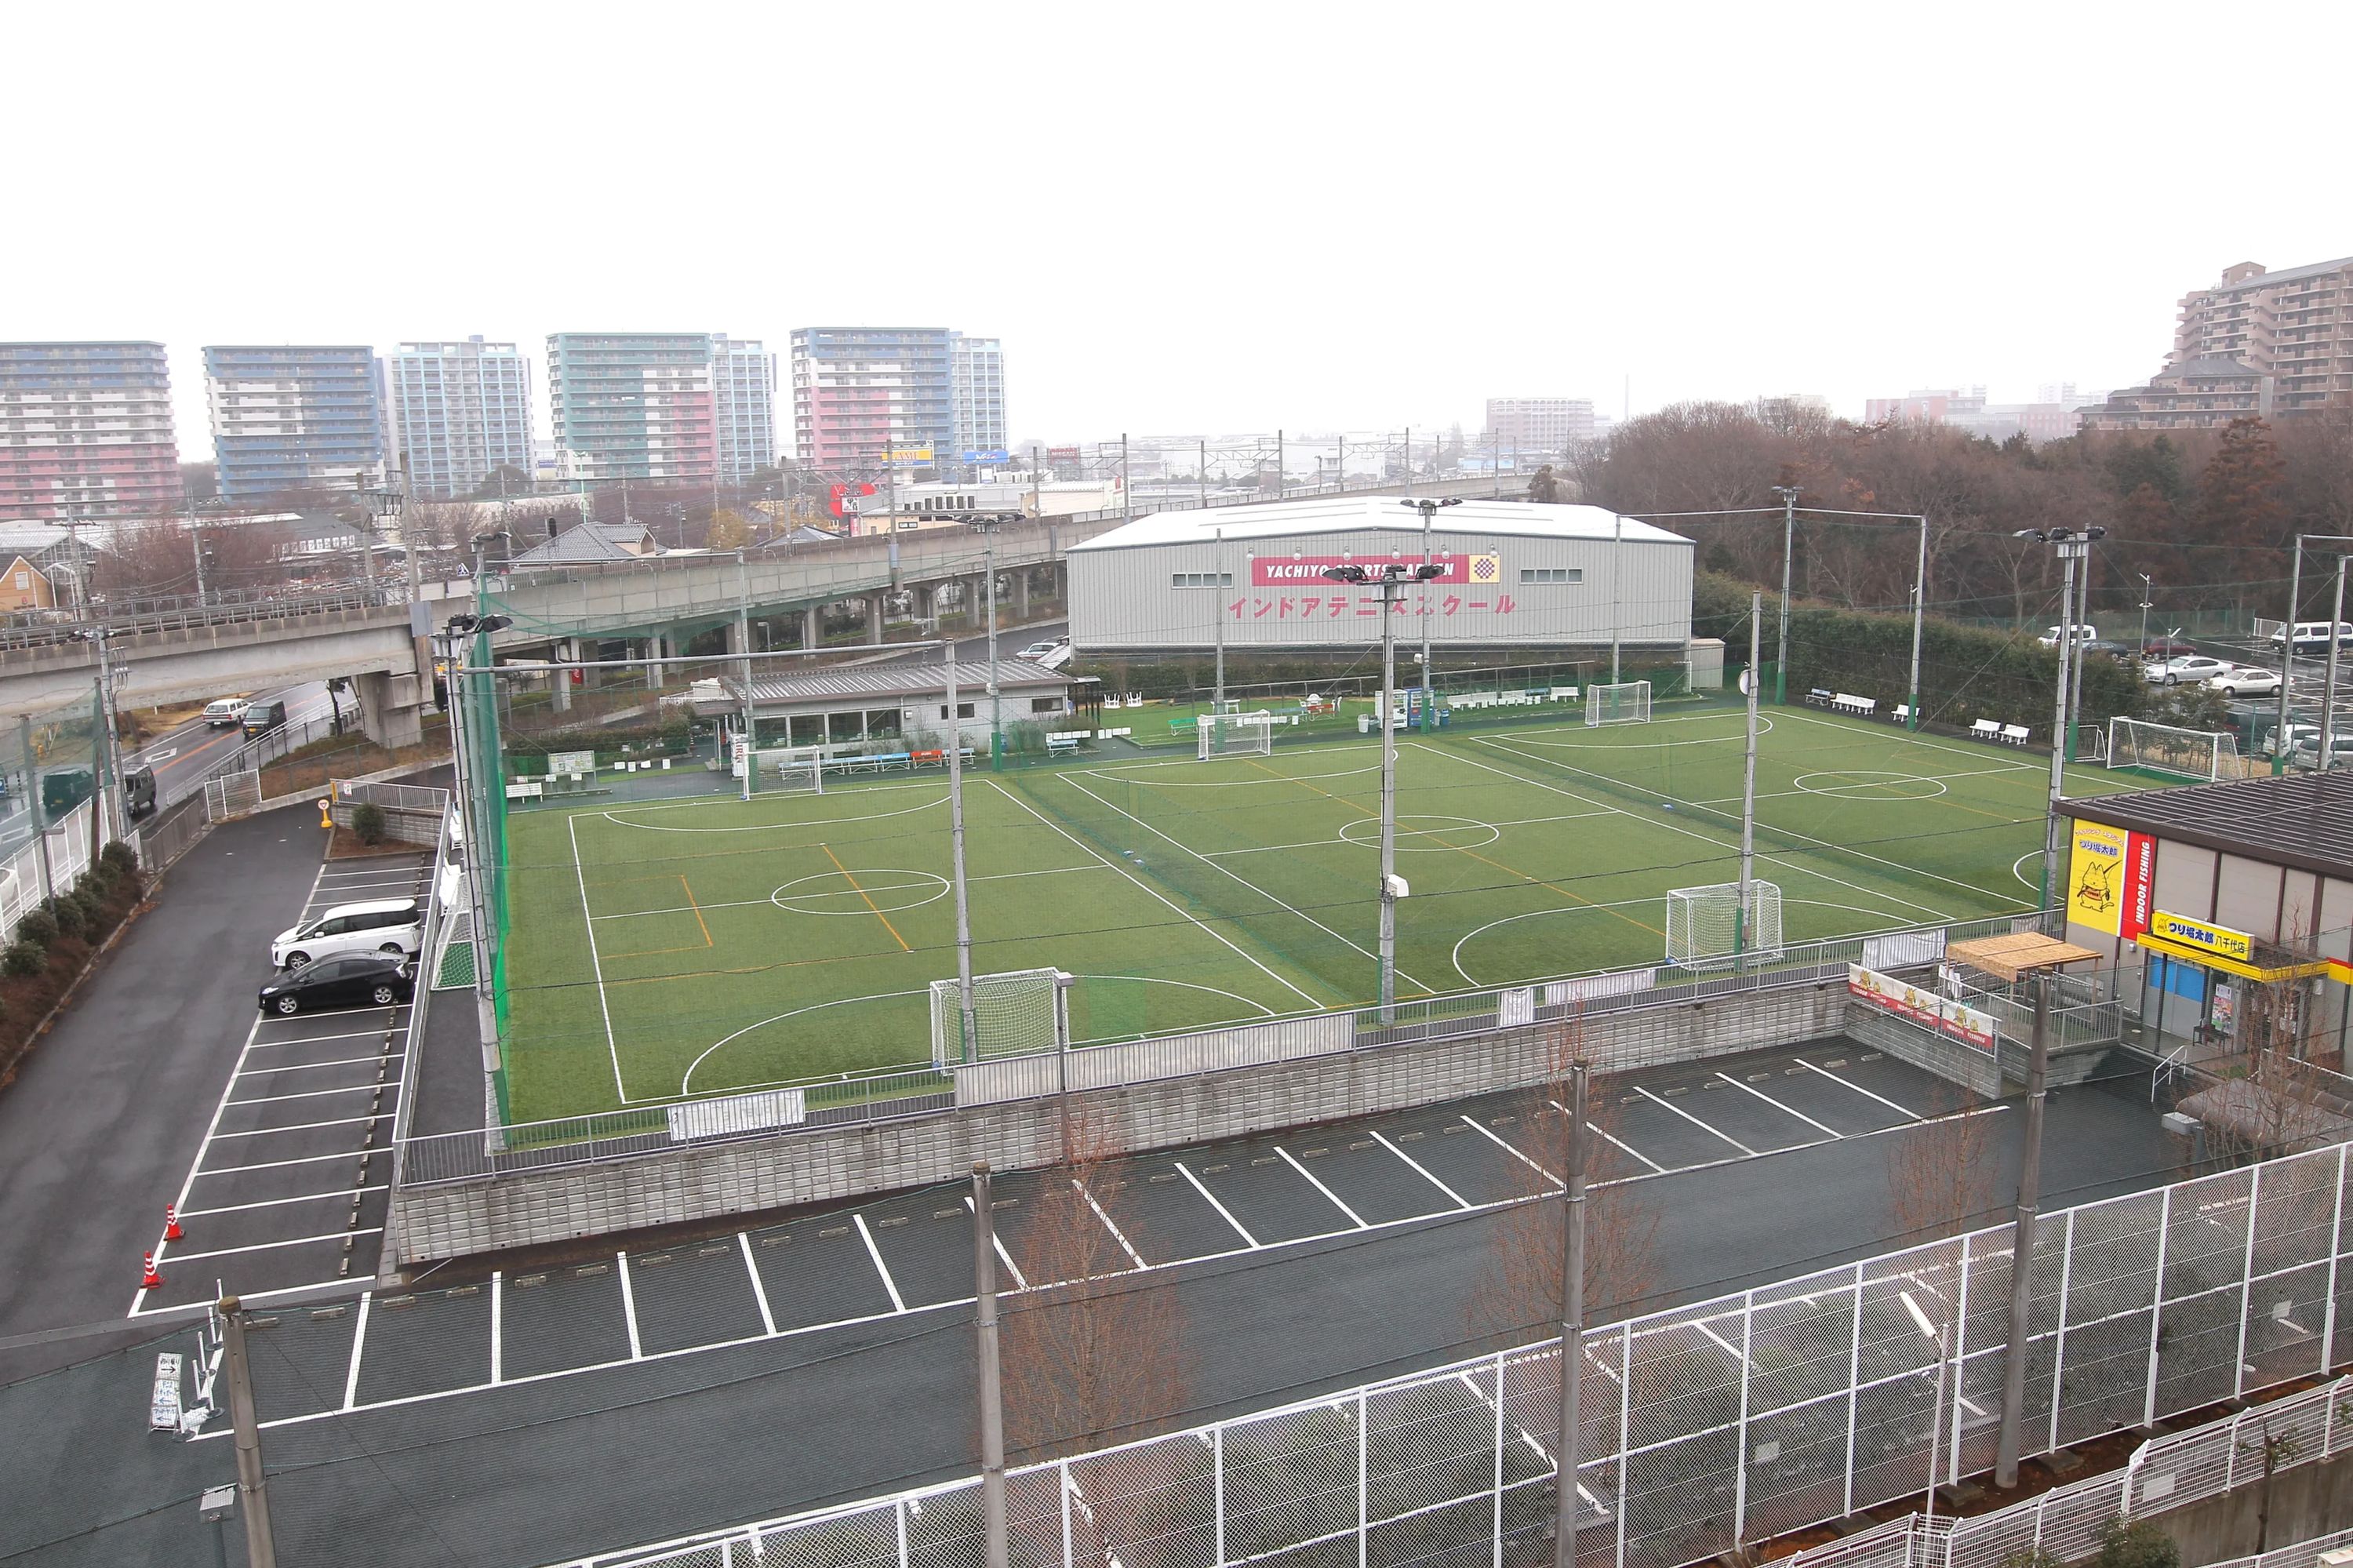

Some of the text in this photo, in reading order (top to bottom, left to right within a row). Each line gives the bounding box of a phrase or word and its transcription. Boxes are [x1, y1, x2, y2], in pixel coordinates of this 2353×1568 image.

[2135, 841, 2150, 925] INDOOR FISHING
[2169, 922, 2246, 954] つり堀太郎 八千代店
